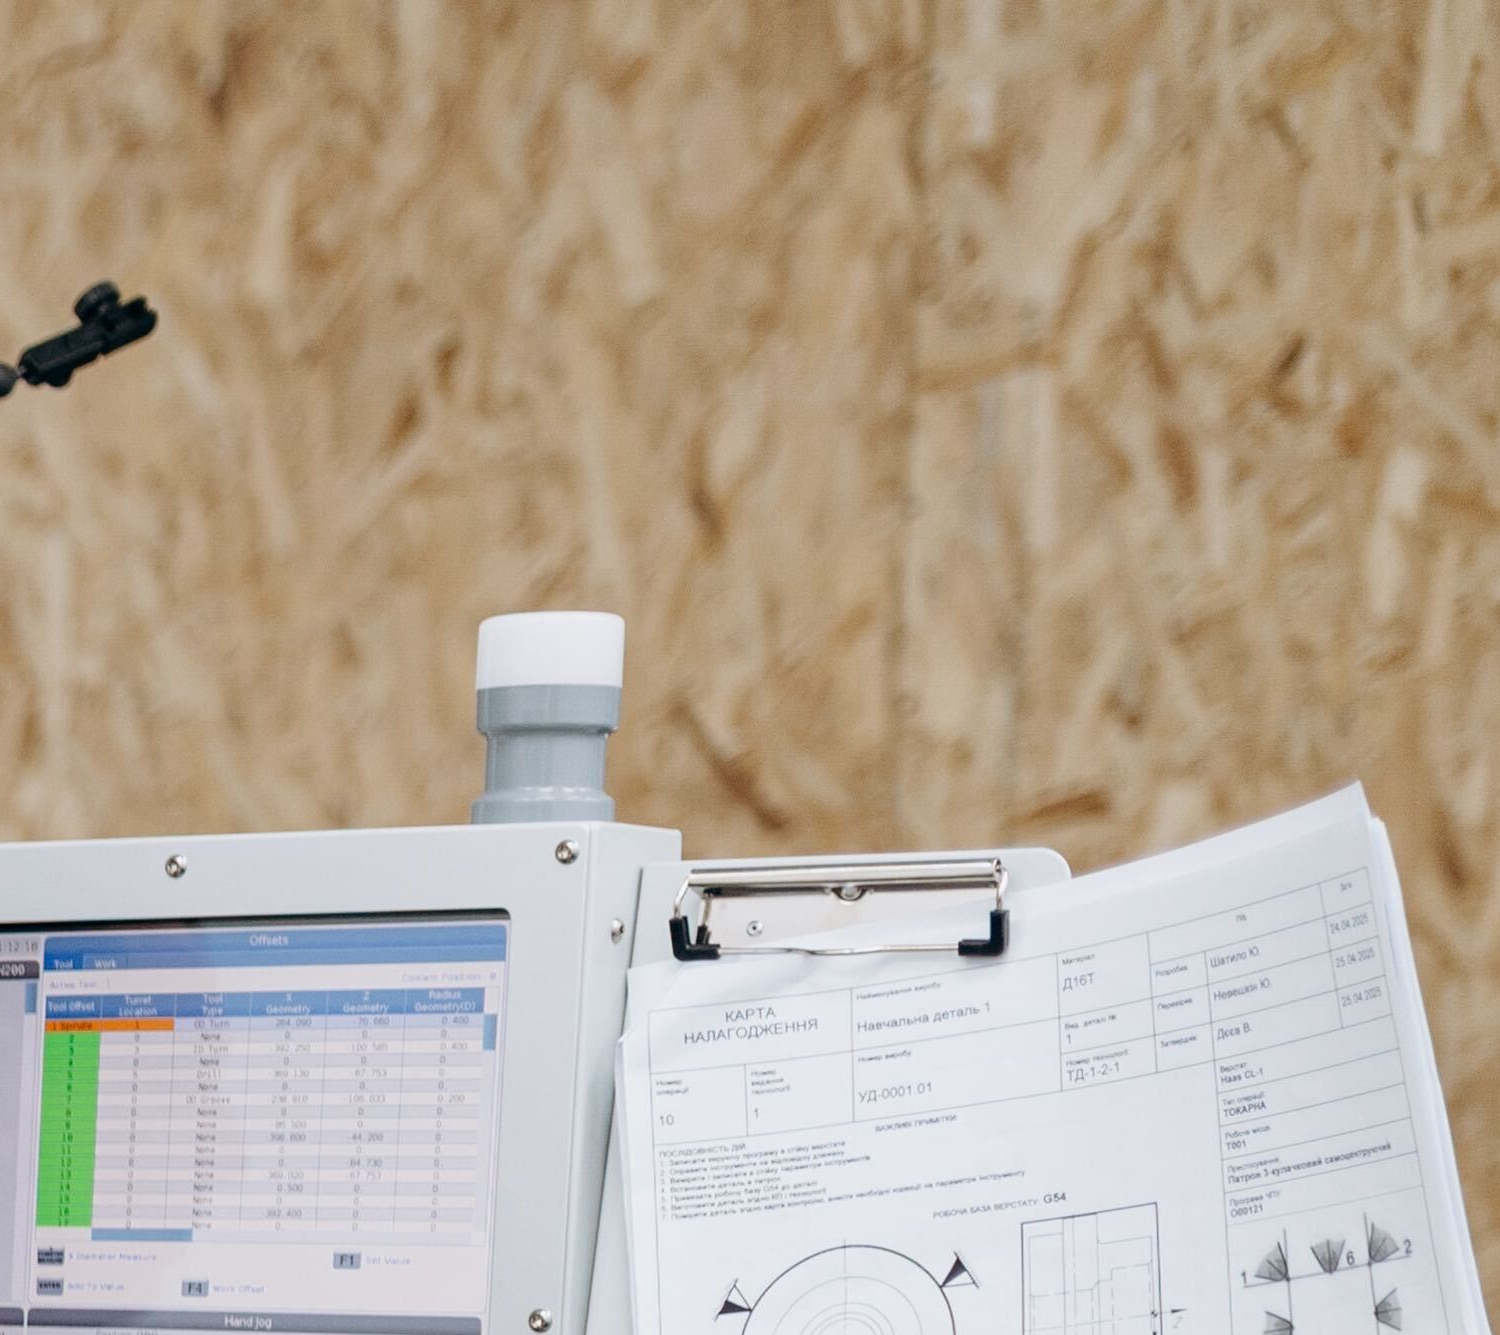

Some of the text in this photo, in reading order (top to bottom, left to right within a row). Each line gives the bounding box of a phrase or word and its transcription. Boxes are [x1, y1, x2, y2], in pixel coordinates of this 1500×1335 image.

[1330, 913, 1369, 934] 24.04.2025
[250, 934, 289, 946] Offsets
[54, 959, 73, 969] Tool
[94, 959, 116, 969] Work
[1063, 972, 1095, 991] Д16Т
[428, 990, 461, 1000] Radius
[266, 1003, 311, 1015] Geometry
[343, 1003, 390, 1014] Geometry
[725, 1007, 776, 1023] КАРТА
[857, 1002, 990, 1032] Навчальна деталь 1
[684, 1018, 819, 1044] НАЛАГОДЖЕННЯ
[1068, 1062, 1120, 1082] ТД-1-2-1
[1221, 1074, 1242, 1084] Haas
[754, 1108, 759, 1119] 1
[1224, 1102, 1267, 1118] ТОКАРНА
[659, 1114, 675, 1126] 10
[1043, 1192, 1066, 1204] G54
[1403, 1240, 1412, 1255] 2
[340, 1255, 355, 1265] F1
[1346, 1252, 1355, 1266] 6
[1241, 1271, 1248, 1284] 1
[224, 1315, 272, 1329] Hand Jog
